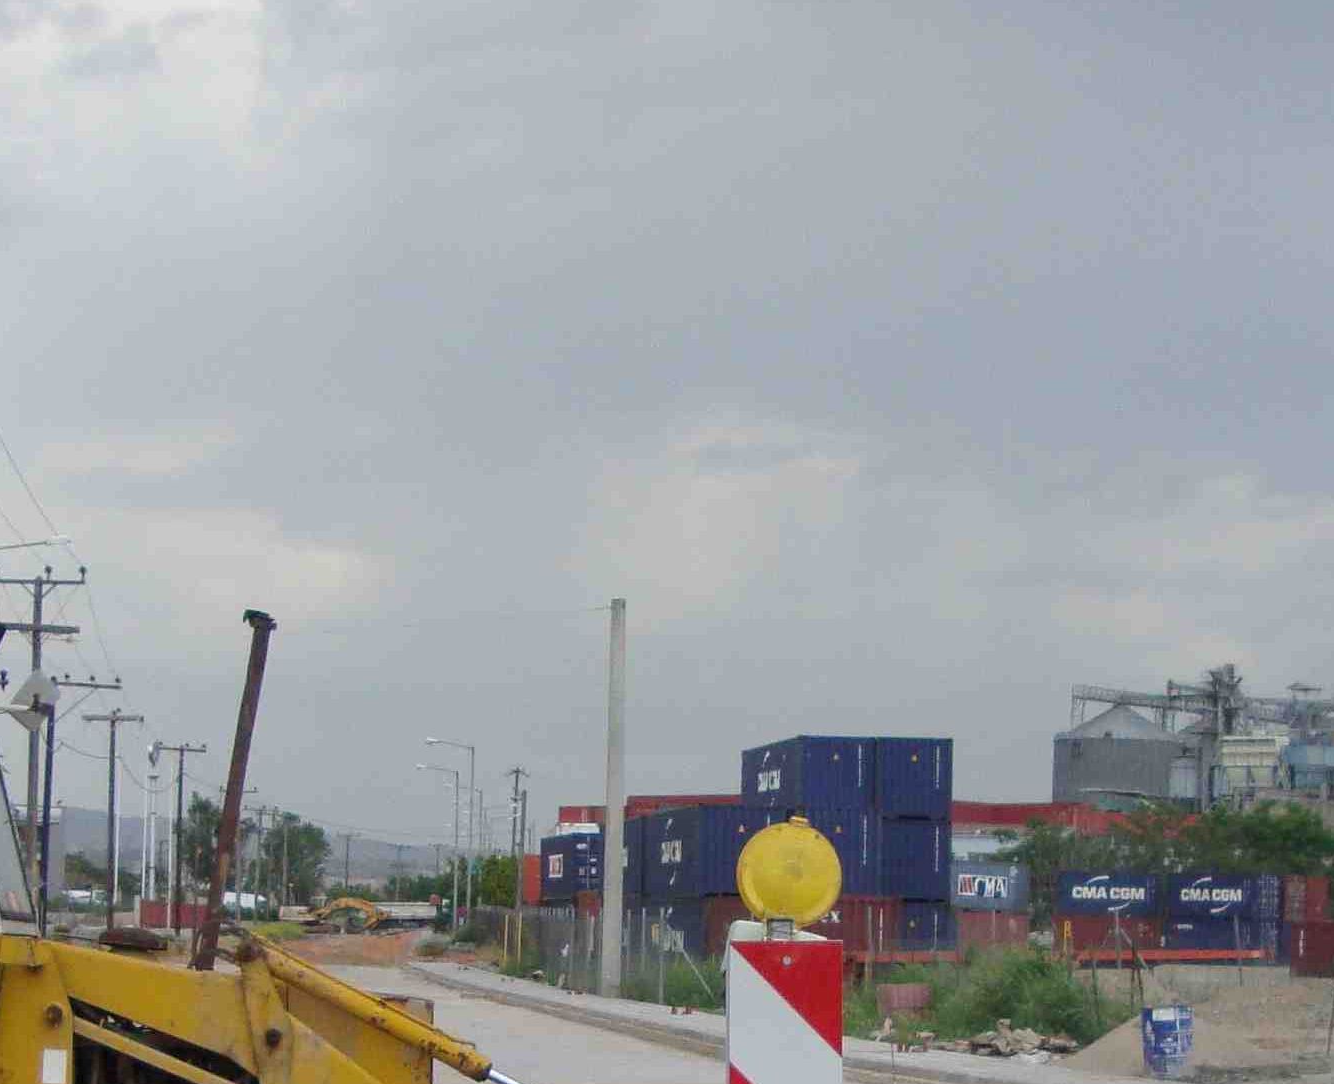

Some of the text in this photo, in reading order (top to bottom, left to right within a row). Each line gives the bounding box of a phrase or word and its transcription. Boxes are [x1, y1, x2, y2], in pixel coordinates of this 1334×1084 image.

[1072, 886, 1145, 900] CMA CGM
[1181, 889, 1242, 902] CMA CGM
